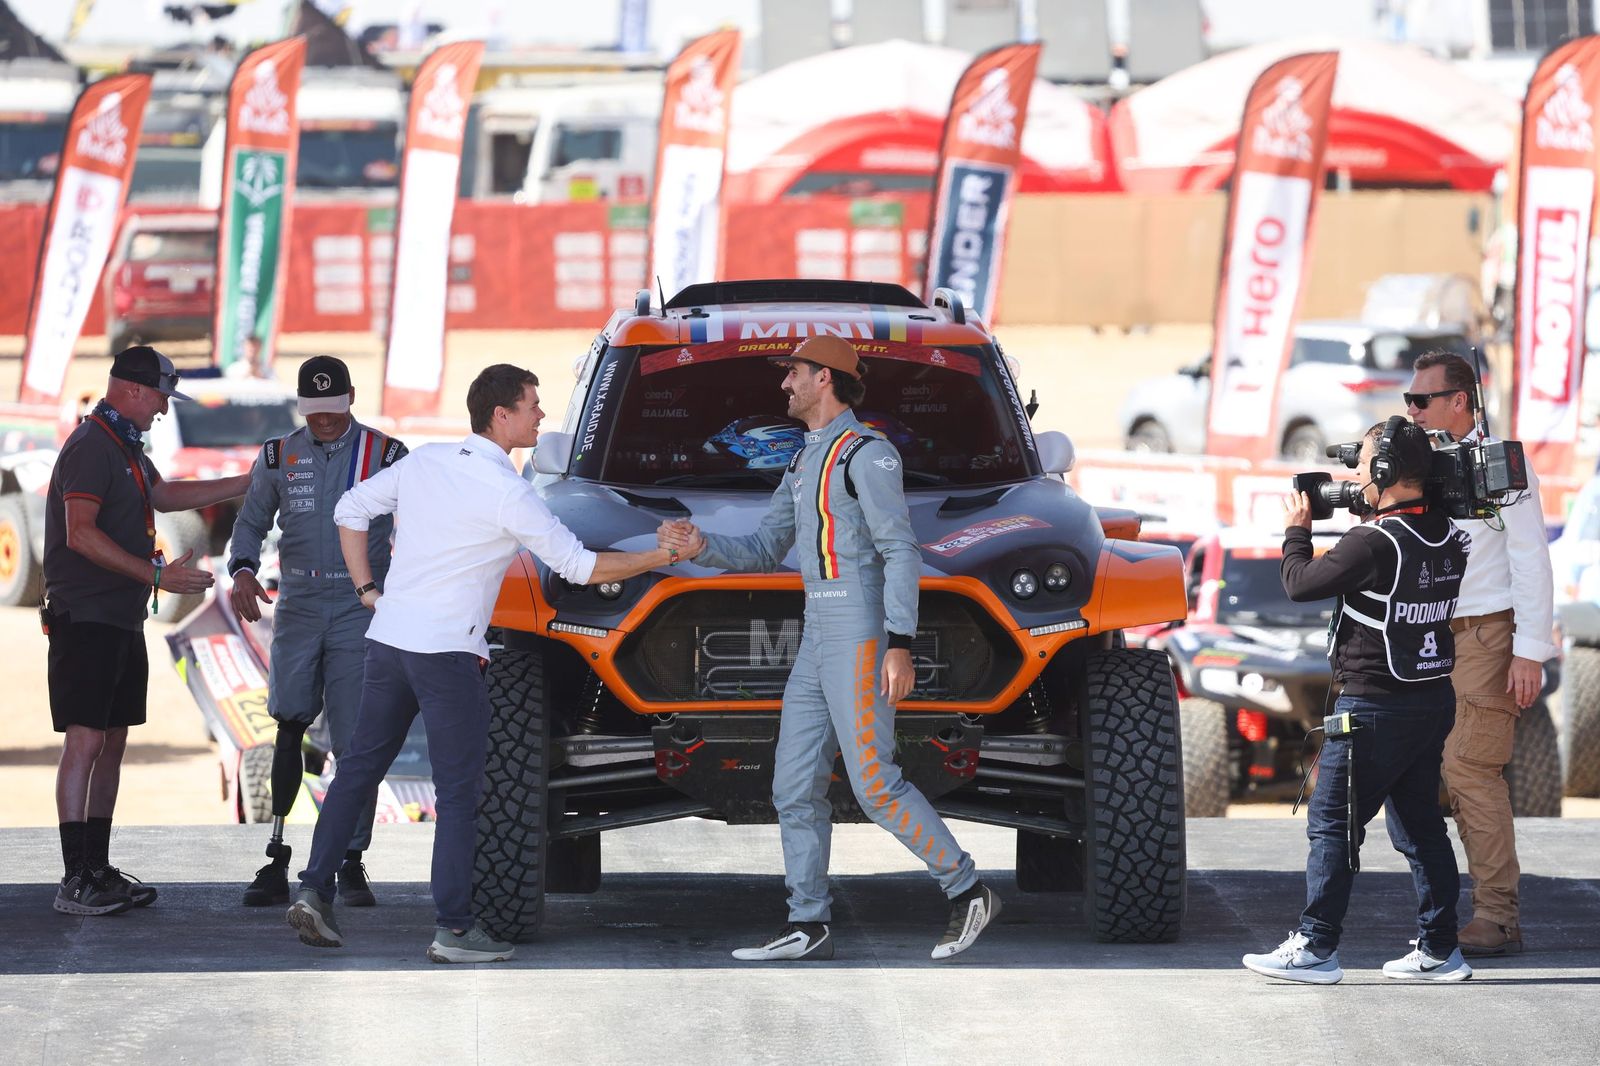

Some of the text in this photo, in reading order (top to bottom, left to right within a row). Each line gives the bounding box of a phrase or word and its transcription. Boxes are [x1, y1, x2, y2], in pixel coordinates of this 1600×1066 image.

[1529, 211, 1578, 399] MOTUL
[740, 321, 874, 340] MINI
[738, 342, 793, 353] DREAM.
[581, 360, 619, 453] WWW.X-RAID.DE
[641, 408, 689, 417] BAUMEL
[995, 360, 1036, 451] WWW.X-RAID.DE
[822, 590, 848, 598] MEVIUS
[1394, 597, 1459, 624] PODIUM T
